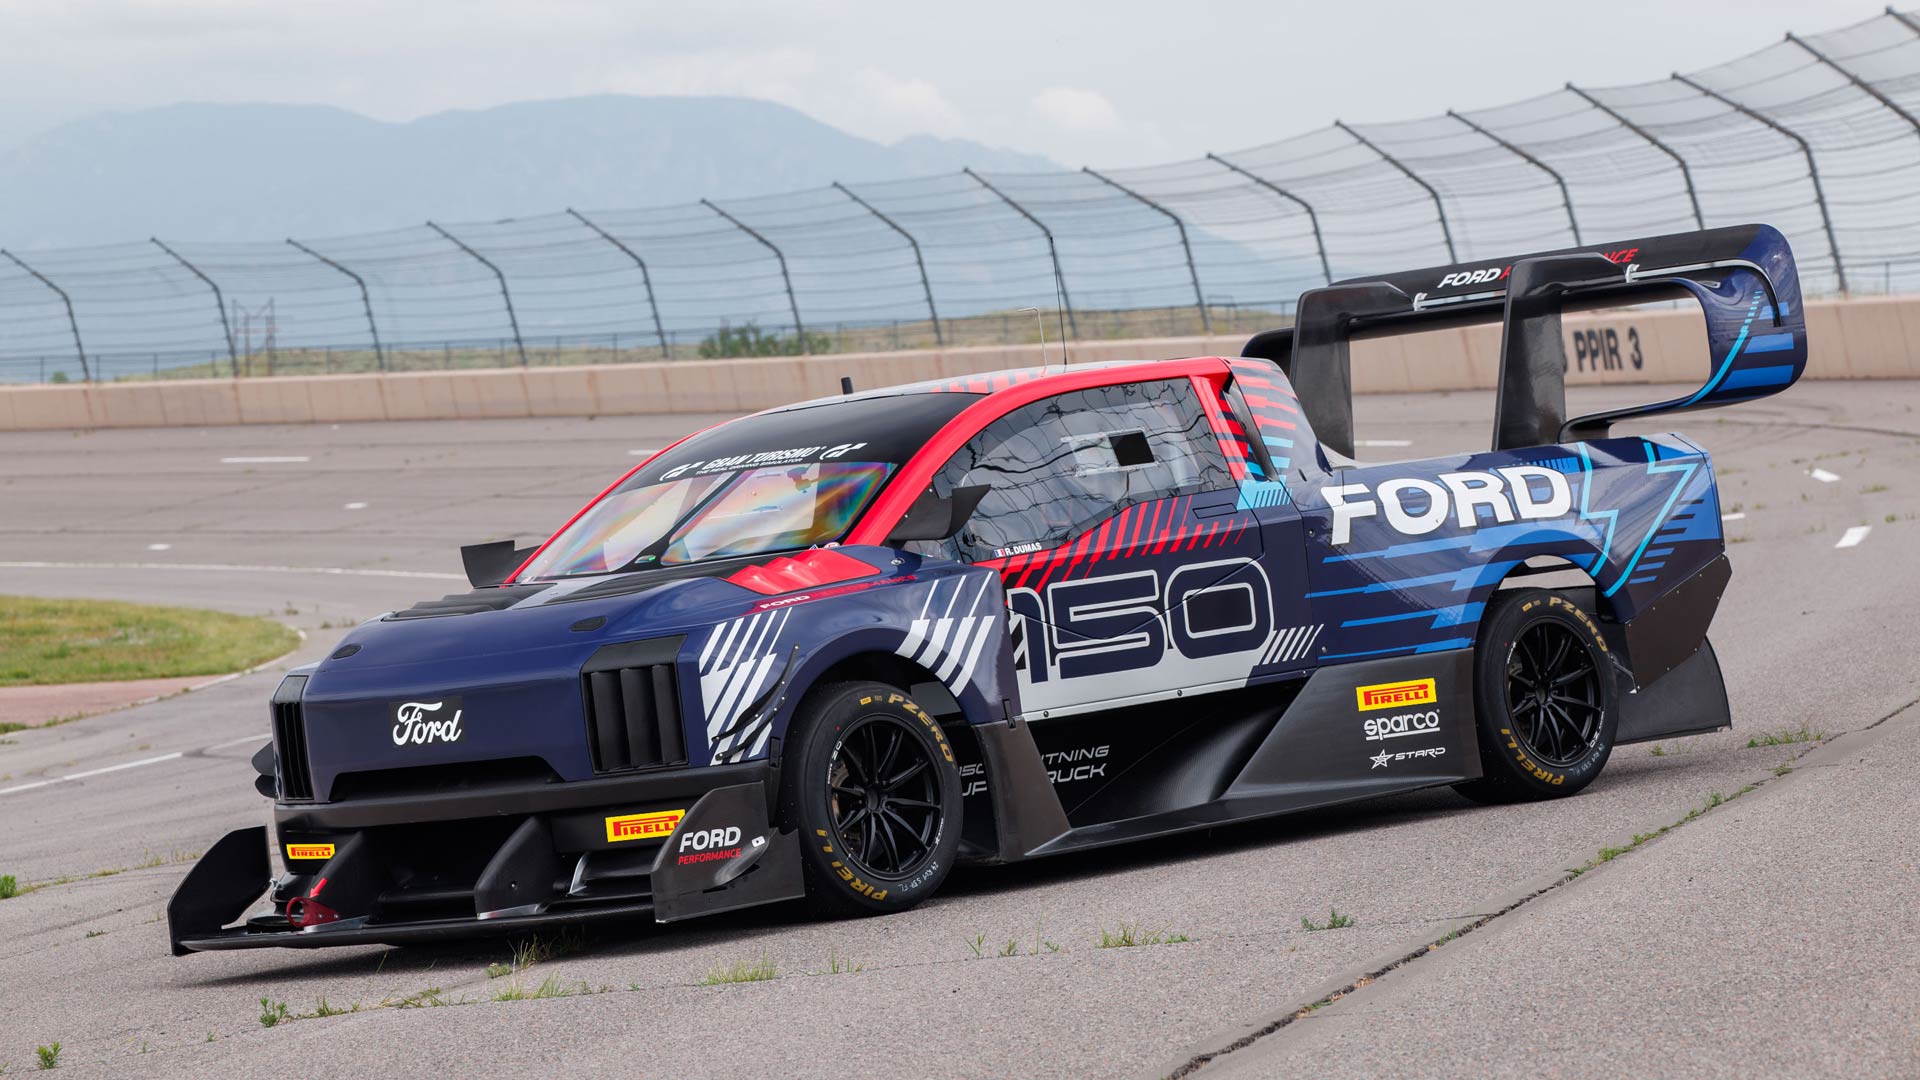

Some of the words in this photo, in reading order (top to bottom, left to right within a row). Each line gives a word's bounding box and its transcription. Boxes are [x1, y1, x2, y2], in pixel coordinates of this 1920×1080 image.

[1437, 267, 1501, 289] FORD
[1573, 328, 1623, 373] PPIR
[1628, 326, 1643, 370] 3
[746, 446, 821, 464] TURISMO
[1320, 465, 1571, 545] FORD
[1013, 542, 1042, 555] DUMAS
[759, 595, 811, 609] FORD
[1363, 683, 1429, 706] PIRELLI
[392, 702, 462, 746] Ford
[1364, 711, 1439, 740] sparco
[1041, 745, 1110, 765] TNING
[1395, 747, 1446, 760] STARD
[1500, 728, 1565, 785] PIRELLI
[679, 826, 741, 852] FORD
[290, 847, 331, 857] PIRELLI
[678, 848, 741, 865] PERFORMANCE
